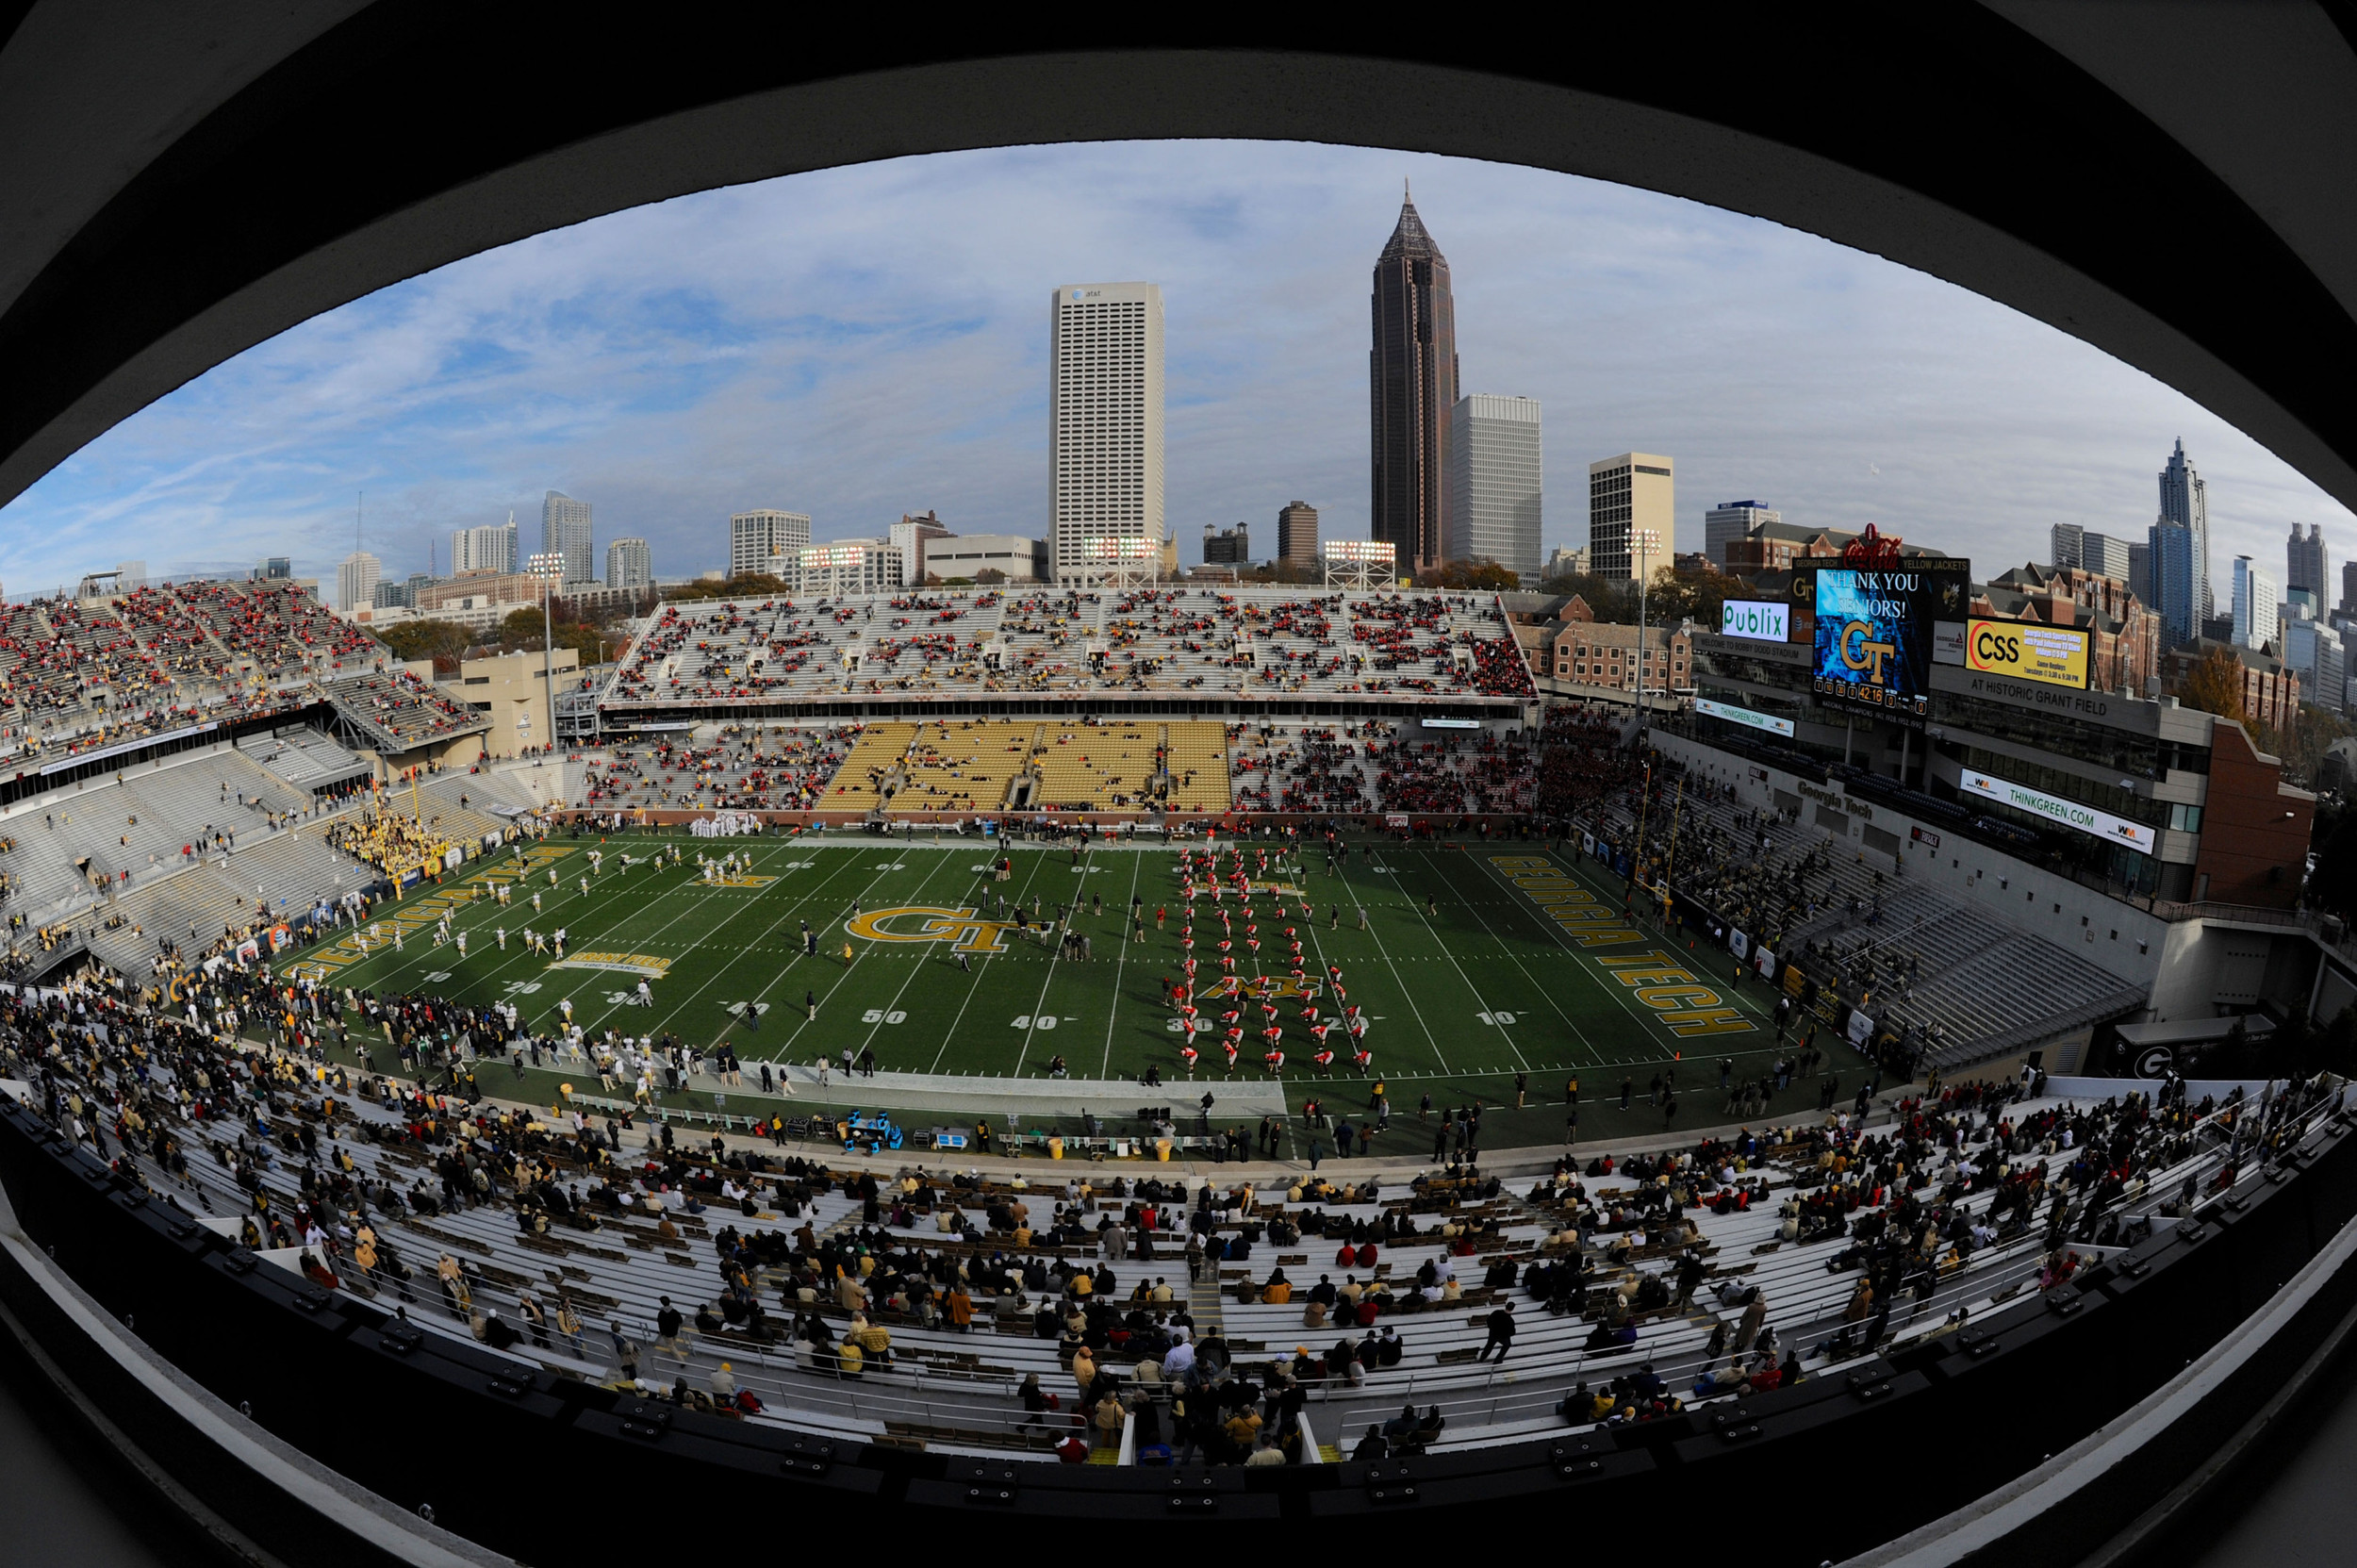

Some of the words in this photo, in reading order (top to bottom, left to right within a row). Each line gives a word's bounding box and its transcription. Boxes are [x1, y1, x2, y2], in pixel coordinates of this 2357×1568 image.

[1821, 558, 1838, 567] TECH
[1904, 560, 1933, 569] YELLOW
[1933, 560, 1968, 570] JACKETS
[1793, 576, 1814, 602] GT
[1828, 572, 1878, 590] THANK
[1884, 573, 1920, 591] YOU
[1838, 598, 1906, 618] SENIORS!
[1723, 605, 1782, 636] Publix
[1701, 638, 1726, 649] WELCOME
[1726, 639, 1734, 649] TO
[1735, 641, 1754, 652] BOBBY
[1755, 644, 1772, 655] DODD
[1772, 646, 1800, 659] STADIUM
[1839, 619, 1895, 684] GT
[1977, 632, 2019, 663] CSS
[1859, 686, 1882, 702] 42:16
[1971, 678, 1984, 691] AT
[1986, 681, 2034, 701] HISTORIC
[2036, 689, 2072, 709] GRANT
[2075, 698, 2107, 717] FIELD
[1721, 707, 1764, 726] THINKGREEN.COM
[1797, 781, 1841, 809] Georgia
[1844, 797, 1872, 820] Tech
[2009, 789, 2094, 828] THINKGREEN.COM
[2118, 825, 2136, 839] WM
[844, 906, 1054, 953] GT
[1489, 856, 1648, 948] GEORGIA
[1594, 949, 1759, 1038] TECH
[569, 951, 629, 964] GRANT
[623, 953, 671, 968] FIELD
[604, 963, 639, 971] YEARS
[431, 972, 453, 983] 10
[503, 981, 543, 994] 20
[726, 1000, 770, 1016] 40
[861, 1009, 908, 1024] 50
[1010, 1015, 1058, 1030] 40
[1166, 1017, 1213, 1032] 30
[1475, 1011, 1517, 1026] 10
